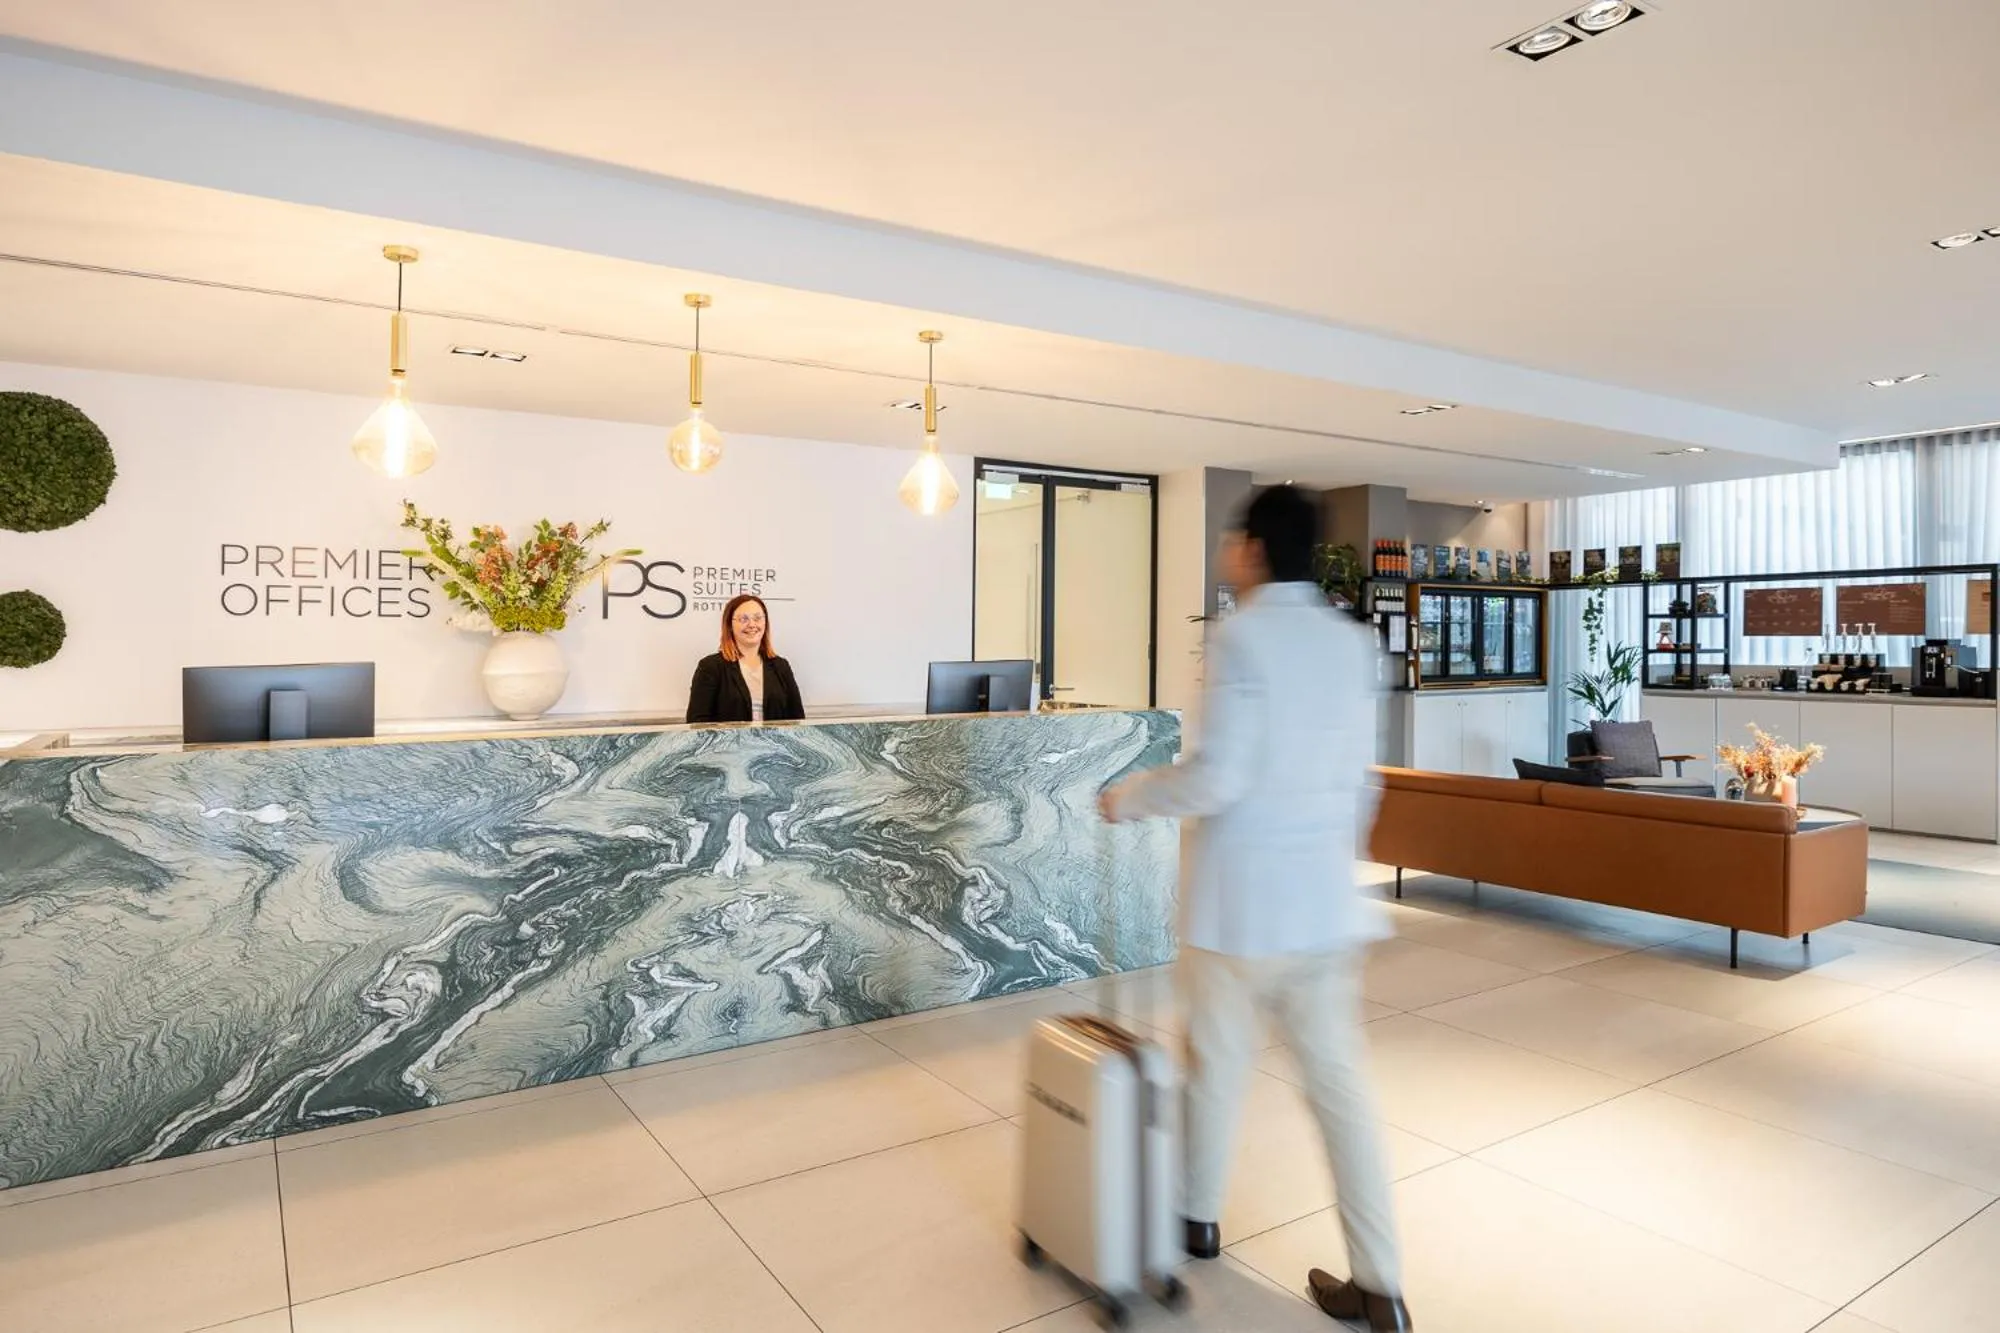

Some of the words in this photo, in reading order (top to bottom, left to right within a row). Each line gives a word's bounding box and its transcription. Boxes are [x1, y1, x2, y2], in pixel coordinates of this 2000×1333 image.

[693, 566, 776, 582] PREMIER
[602, 559, 687, 619] PS
[693, 581, 762, 596] SUITES
[221, 583, 431, 618] OFFICES
[693, 602, 723, 611] ROTT
